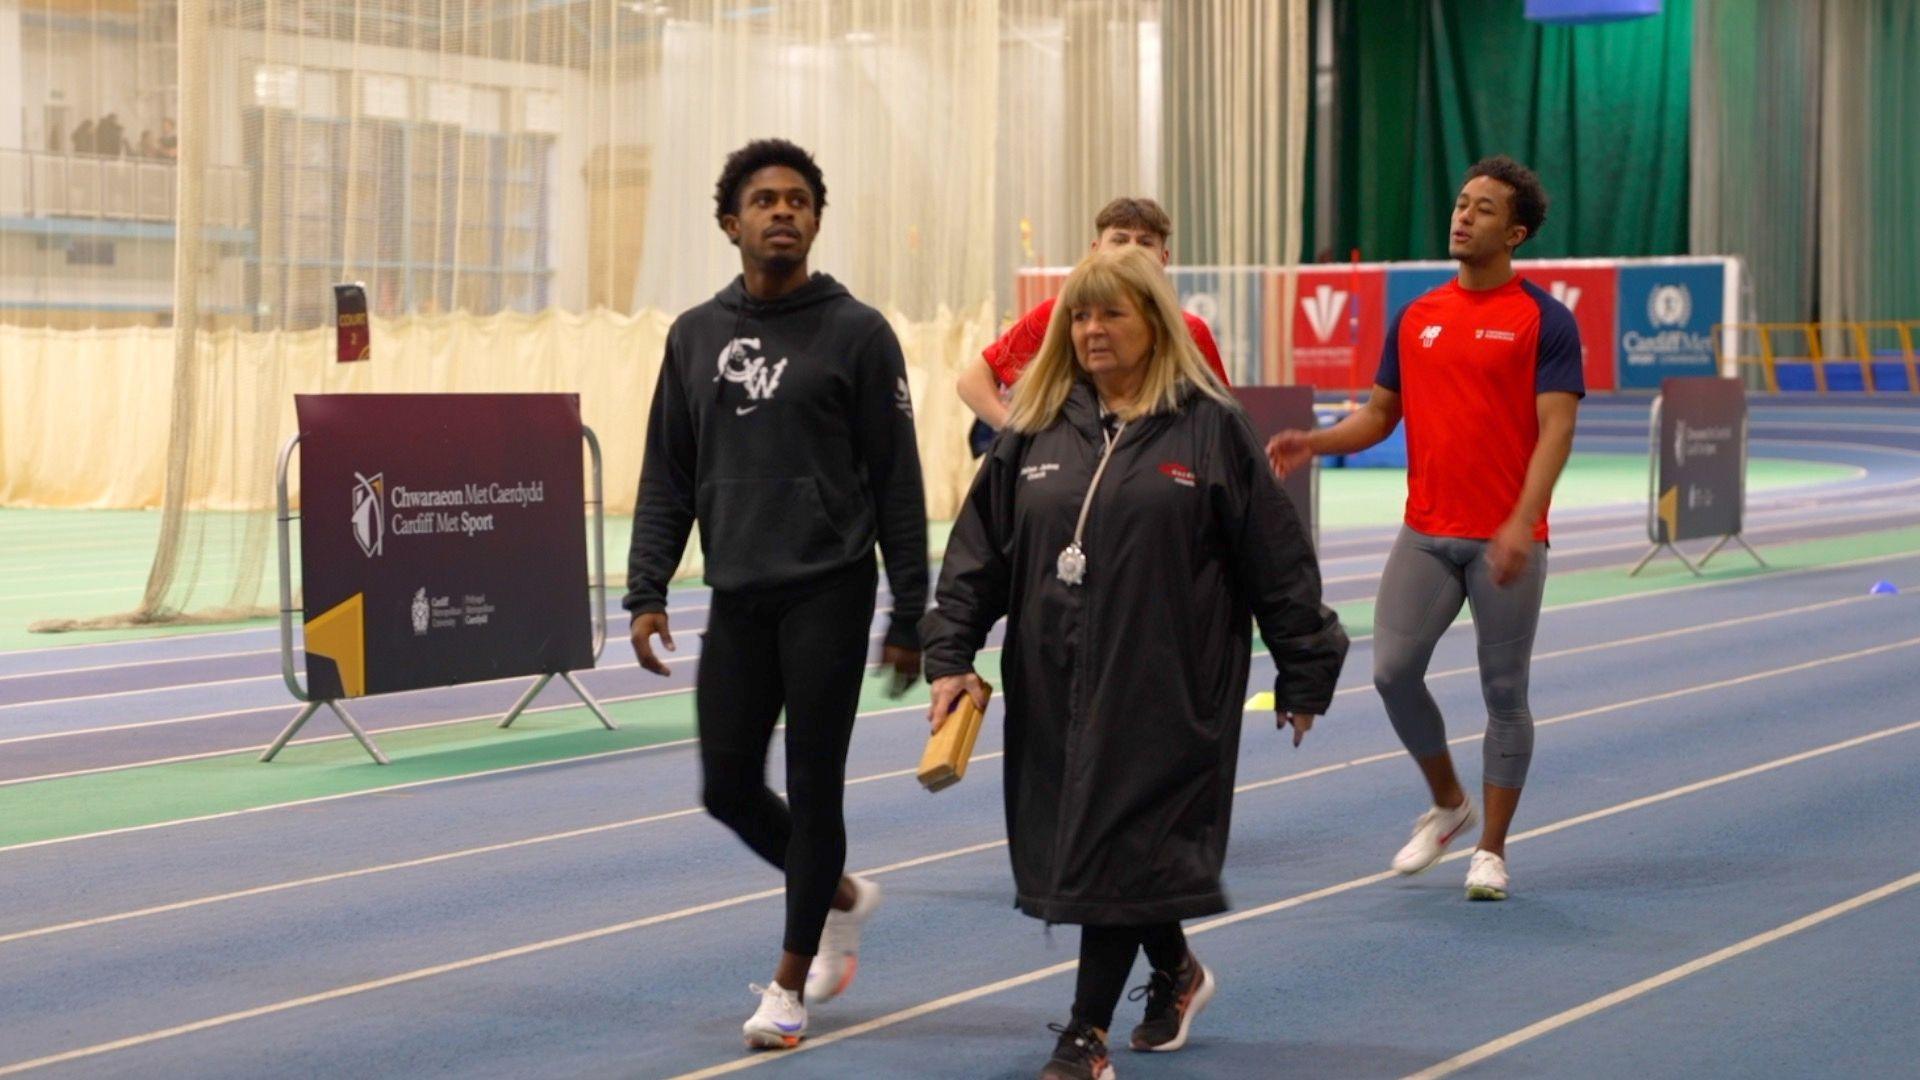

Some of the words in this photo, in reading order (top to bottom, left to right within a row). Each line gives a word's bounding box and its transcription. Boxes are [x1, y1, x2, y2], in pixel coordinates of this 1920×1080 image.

[1623, 331, 1681, 353] Cardiff
[391, 486, 464, 508] Chwaraeon
[465, 484, 489, 505] Met
[489, 481, 544, 508] Caerdydd
[392, 512, 435, 536] Cardiff
[436, 512, 460, 533] Met
[461, 511, 494, 537] Sport
